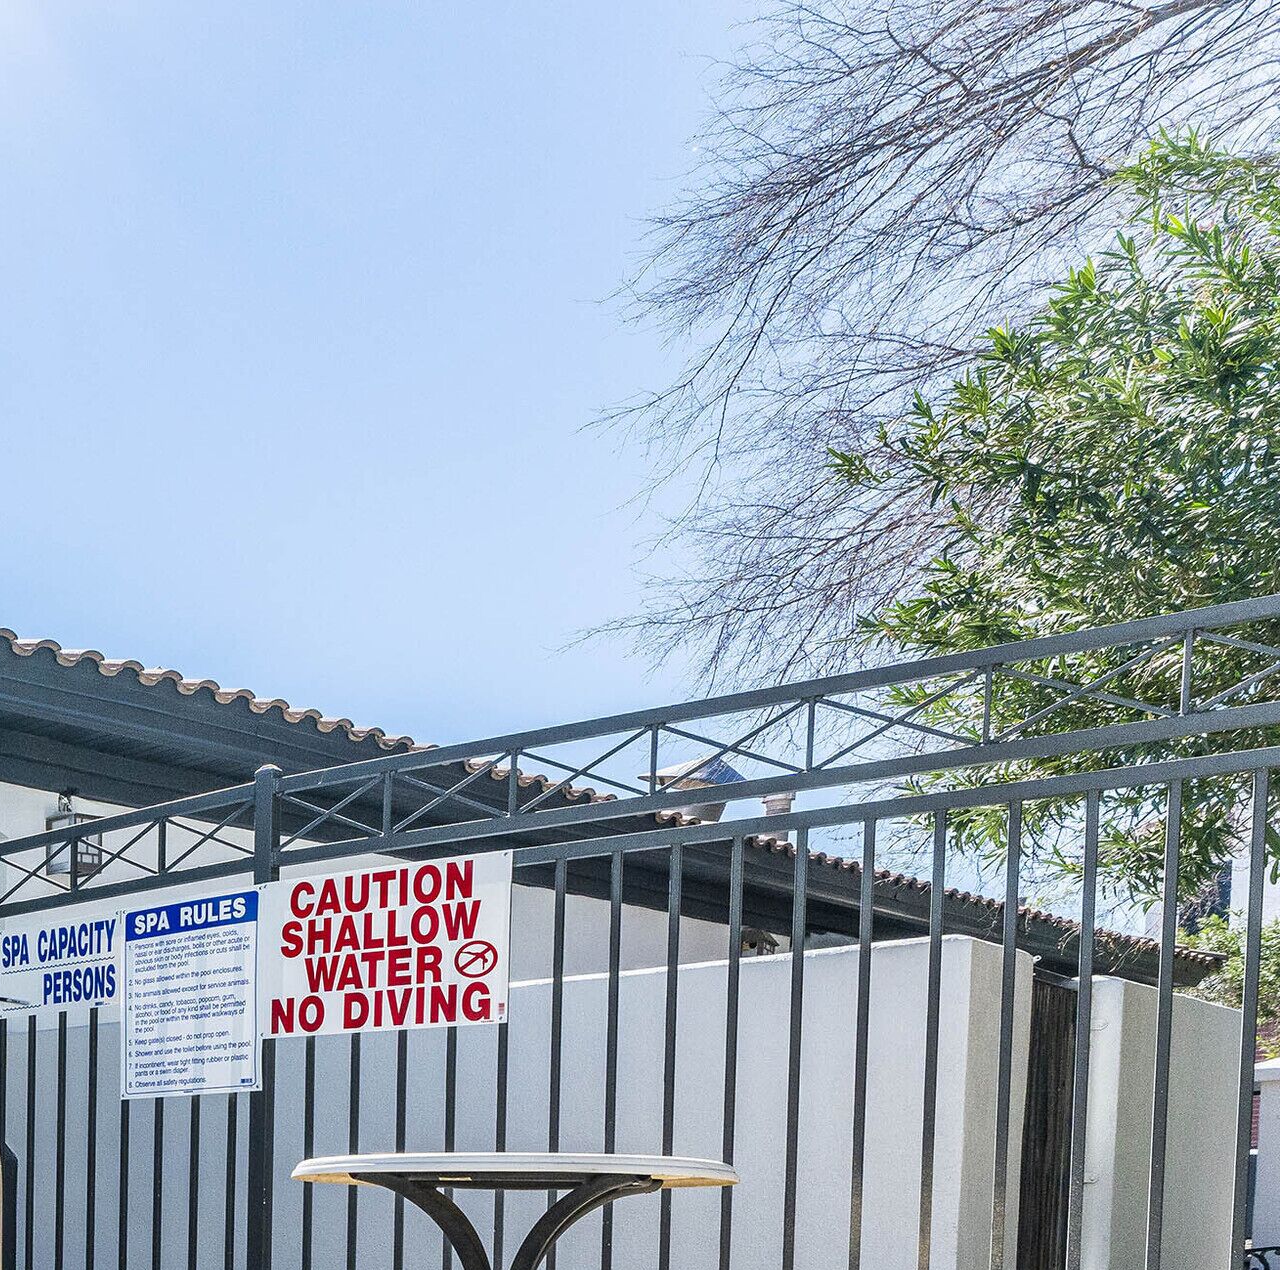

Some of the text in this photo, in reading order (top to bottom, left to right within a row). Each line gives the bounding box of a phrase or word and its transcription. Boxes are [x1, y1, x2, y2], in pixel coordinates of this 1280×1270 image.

[290, 860, 473, 919] CAUTION
[134, 897, 247, 935] SPA RULES
[280, 899, 482, 958] SHALLOW
[2, 918, 116, 968] SPA CAPACITY
[43, 963, 116, 1005] PERSONS
[304, 945, 443, 993] WATER
[271, 981, 491, 1035] NO DIVING
